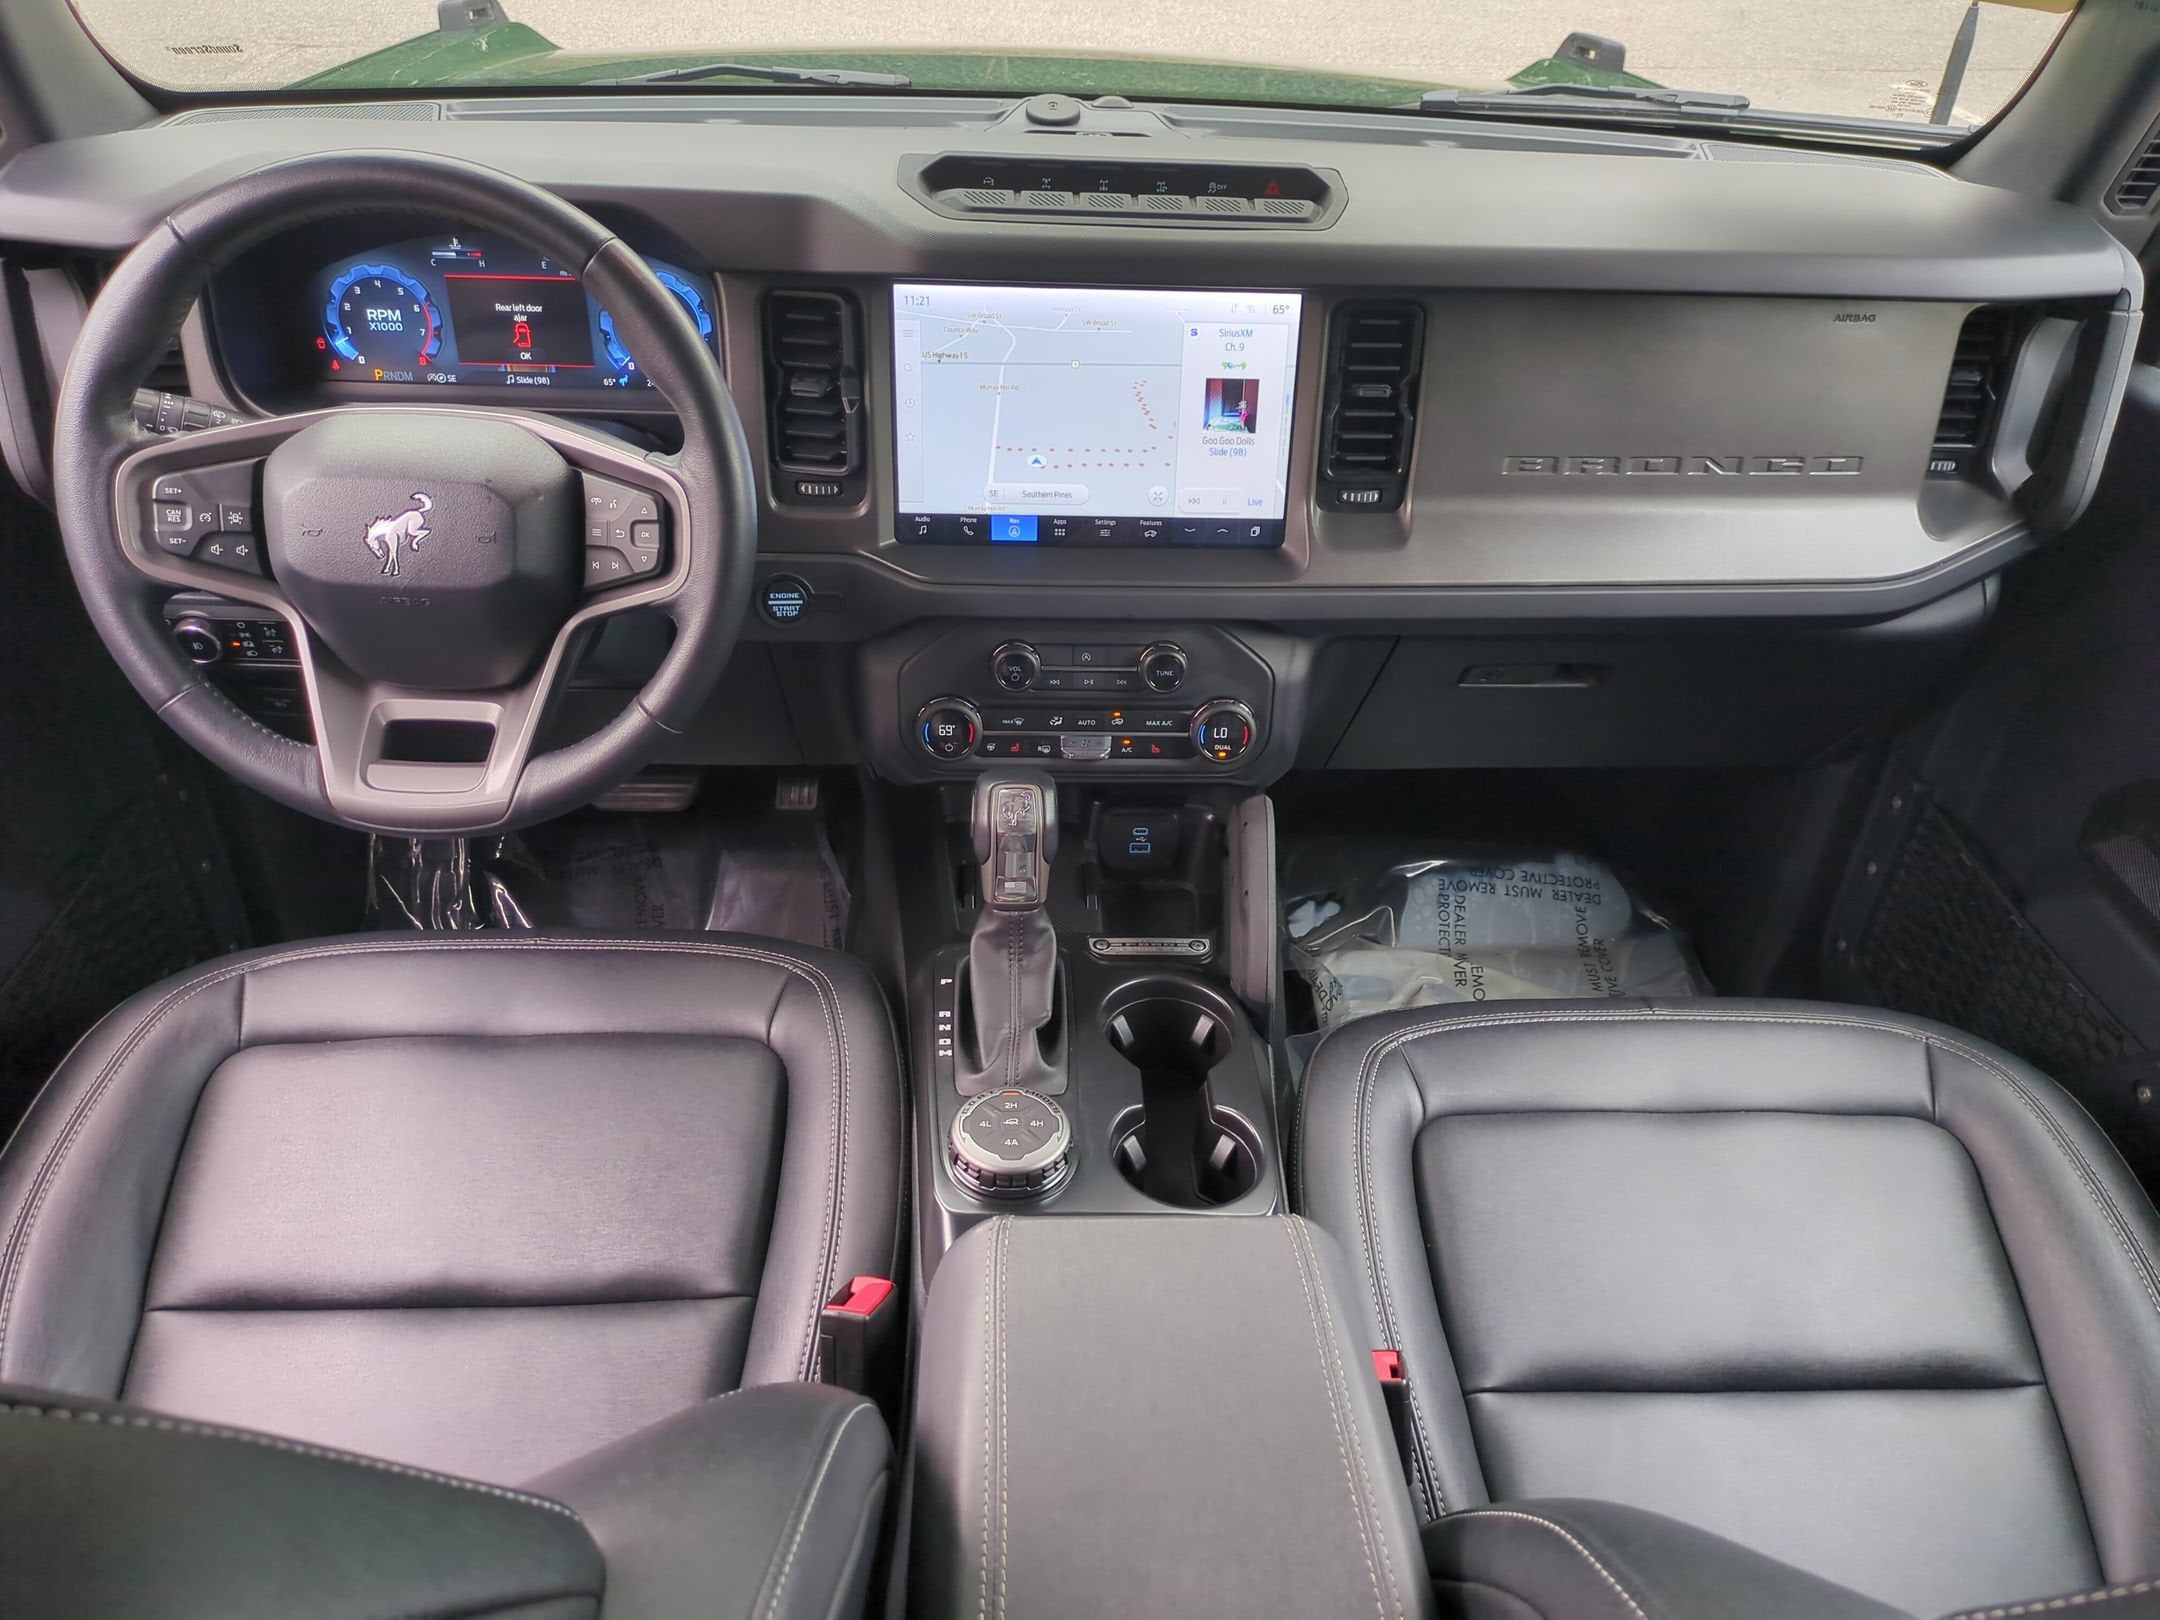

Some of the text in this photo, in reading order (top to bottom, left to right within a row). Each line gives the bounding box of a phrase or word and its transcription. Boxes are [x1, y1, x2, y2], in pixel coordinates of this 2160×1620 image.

[430, 259, 437, 267] C
[479, 260, 486, 268] H
[903, 296, 930, 306] 11:21
[495, 303, 543, 313] Rear left door
[1272, 304, 1290, 314] 65°
[366, 309, 402, 321] RPM
[513, 313, 527, 323] ajar
[1832, 313, 1877, 324] AIRBAG
[370, 322, 403, 331] X1000
[1218, 328, 1253, 338] SiriusXM
[1225, 343, 1245, 352] Ch. 9
[520, 352, 532, 360] OK
[932, 352, 959, 361] Highway
[374, 369, 413, 381] PRNDM
[447, 375, 457, 383] SE
[516, 376, 550, 386] Slide (98)
[603, 378, 616, 386] 65°
[1202, 437, 1255, 446] Goo Goo Dolls
[1209, 448, 1247, 457] Slide (98)
[1501, 456, 1864, 477] BRONCO
[164, 487, 182, 495] SET+
[989, 490, 998, 498] SE
[1022, 490, 1072, 499] Southern Pines
[1247, 497, 1263, 506] Live
[960, 516, 977, 524] Phone
[1053, 518, 1067, 526] Apps
[1094, 519, 1116, 527] Settings
[1139, 519, 1162, 527] Features
[938, 724, 956, 736] 69°
[1213, 727, 1228, 739] LO
[1471, 868, 1600, 890] PROTECTIVE COVER
[1438, 878, 1602, 906] DEALER MUST REMOVE
[1454, 895, 1467, 946] DEALER
[1575, 906, 1603, 992] MUST REMOVE
[1593, 938, 1613, 972] COVER
[979, 1120, 992, 1128] 4L
[1030, 1120, 1044, 1128] 4H
[1004, 1138, 1019, 1146] 4A
